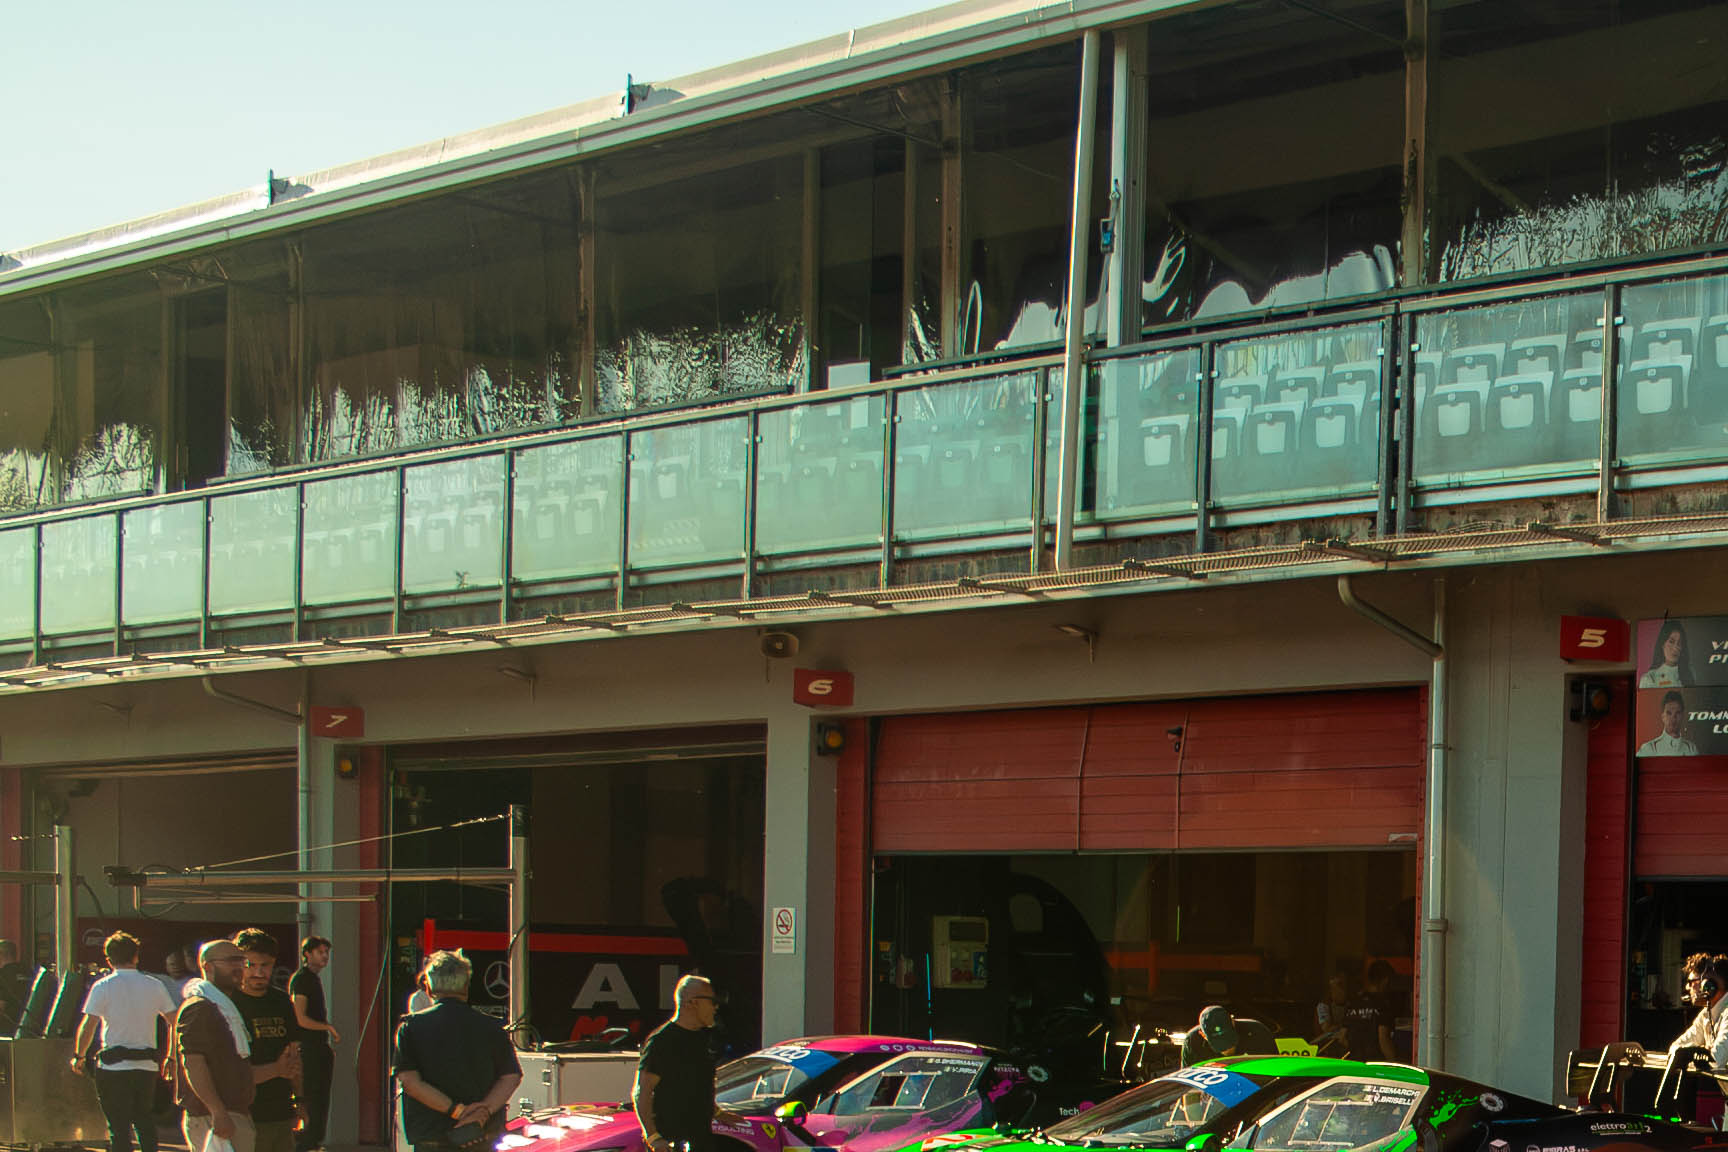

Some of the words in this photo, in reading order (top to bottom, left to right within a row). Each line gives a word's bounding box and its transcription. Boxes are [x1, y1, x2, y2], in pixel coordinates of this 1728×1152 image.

[1577, 628, 1607, 648] 5
[808, 679, 834, 696] 6
[325, 714, 349, 729] 7
